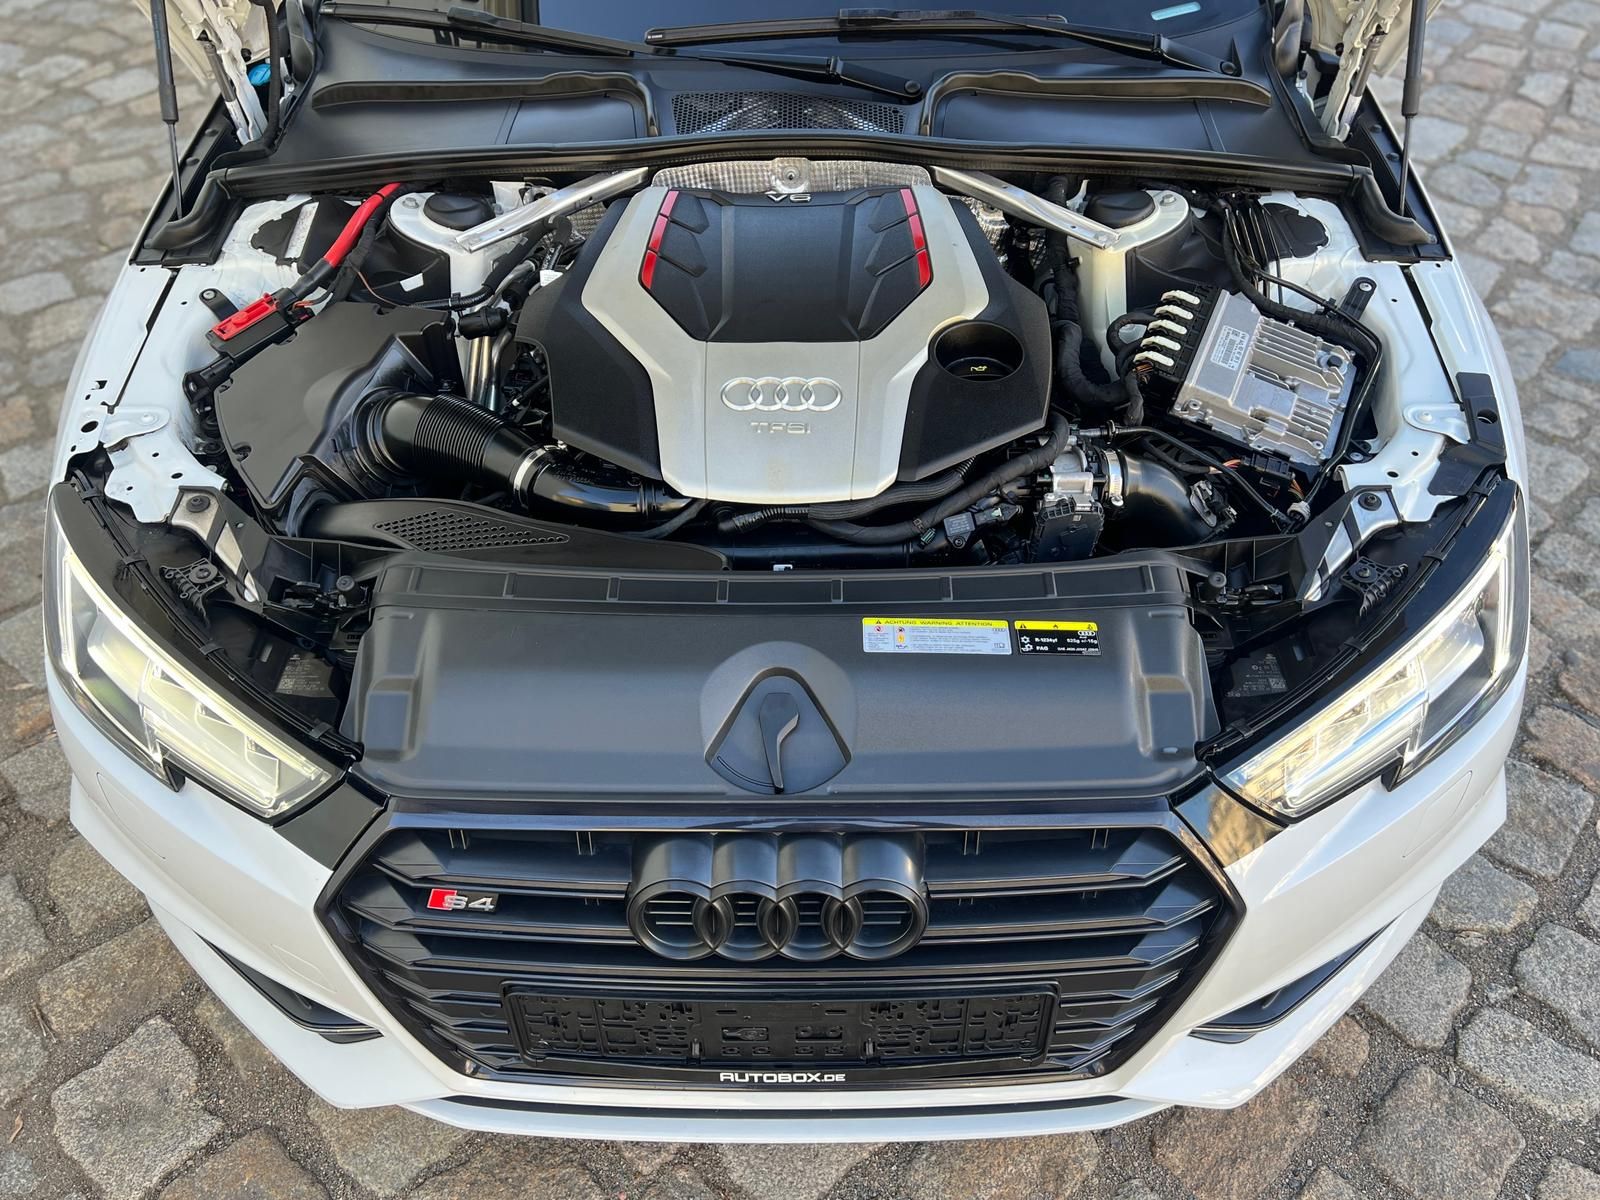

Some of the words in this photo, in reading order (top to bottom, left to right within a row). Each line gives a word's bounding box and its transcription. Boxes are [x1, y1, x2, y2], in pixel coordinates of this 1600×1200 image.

[750, 421, 812, 434] TFSI
[443, 895, 495, 911] S4
[719, 1072, 846, 1083] AUTOBOX.DE
